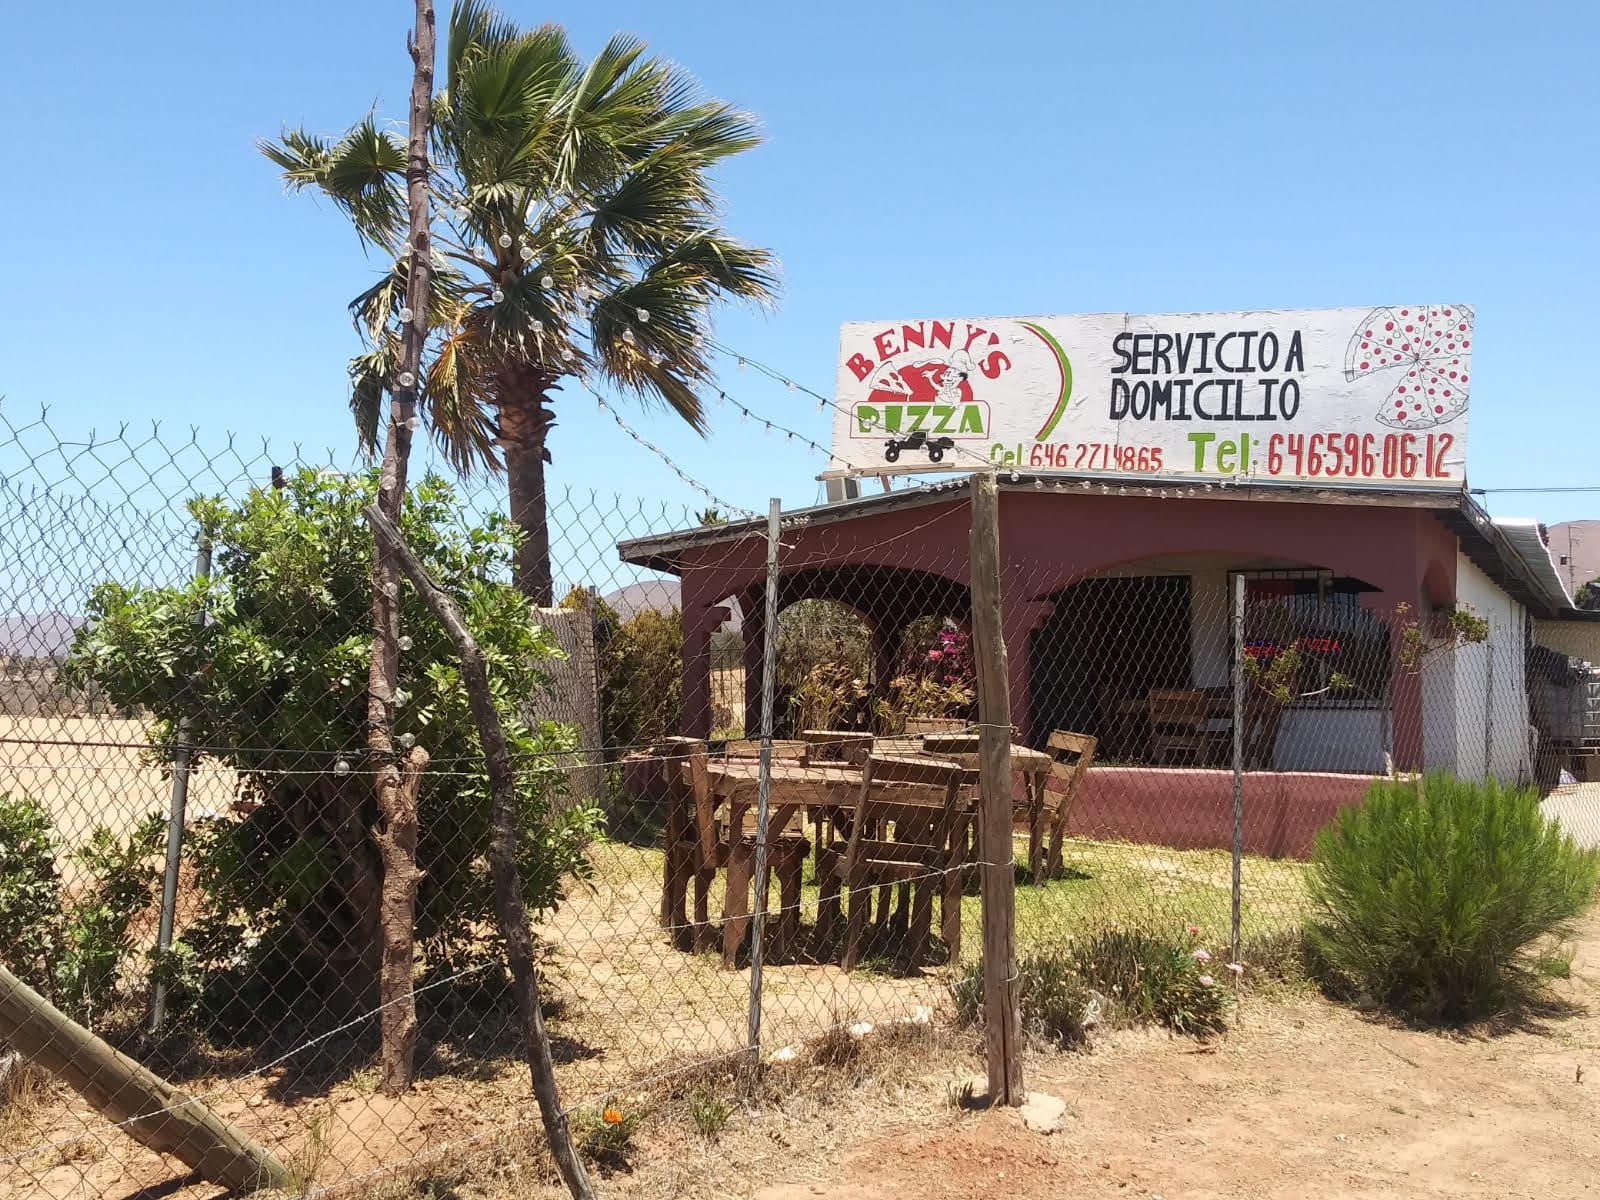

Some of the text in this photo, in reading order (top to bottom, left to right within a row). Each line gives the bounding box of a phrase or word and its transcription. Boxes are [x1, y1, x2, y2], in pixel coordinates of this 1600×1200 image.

[845, 320, 1012, 383] BENNY'S
[1110, 330, 1305, 375] SERVICIO A
[856, 405, 985, 434] PIZZA
[1109, 378, 1300, 421] DOMICILIO
[990, 443, 1022, 468] Cel
[1187, 432, 1260, 474] Tel:
